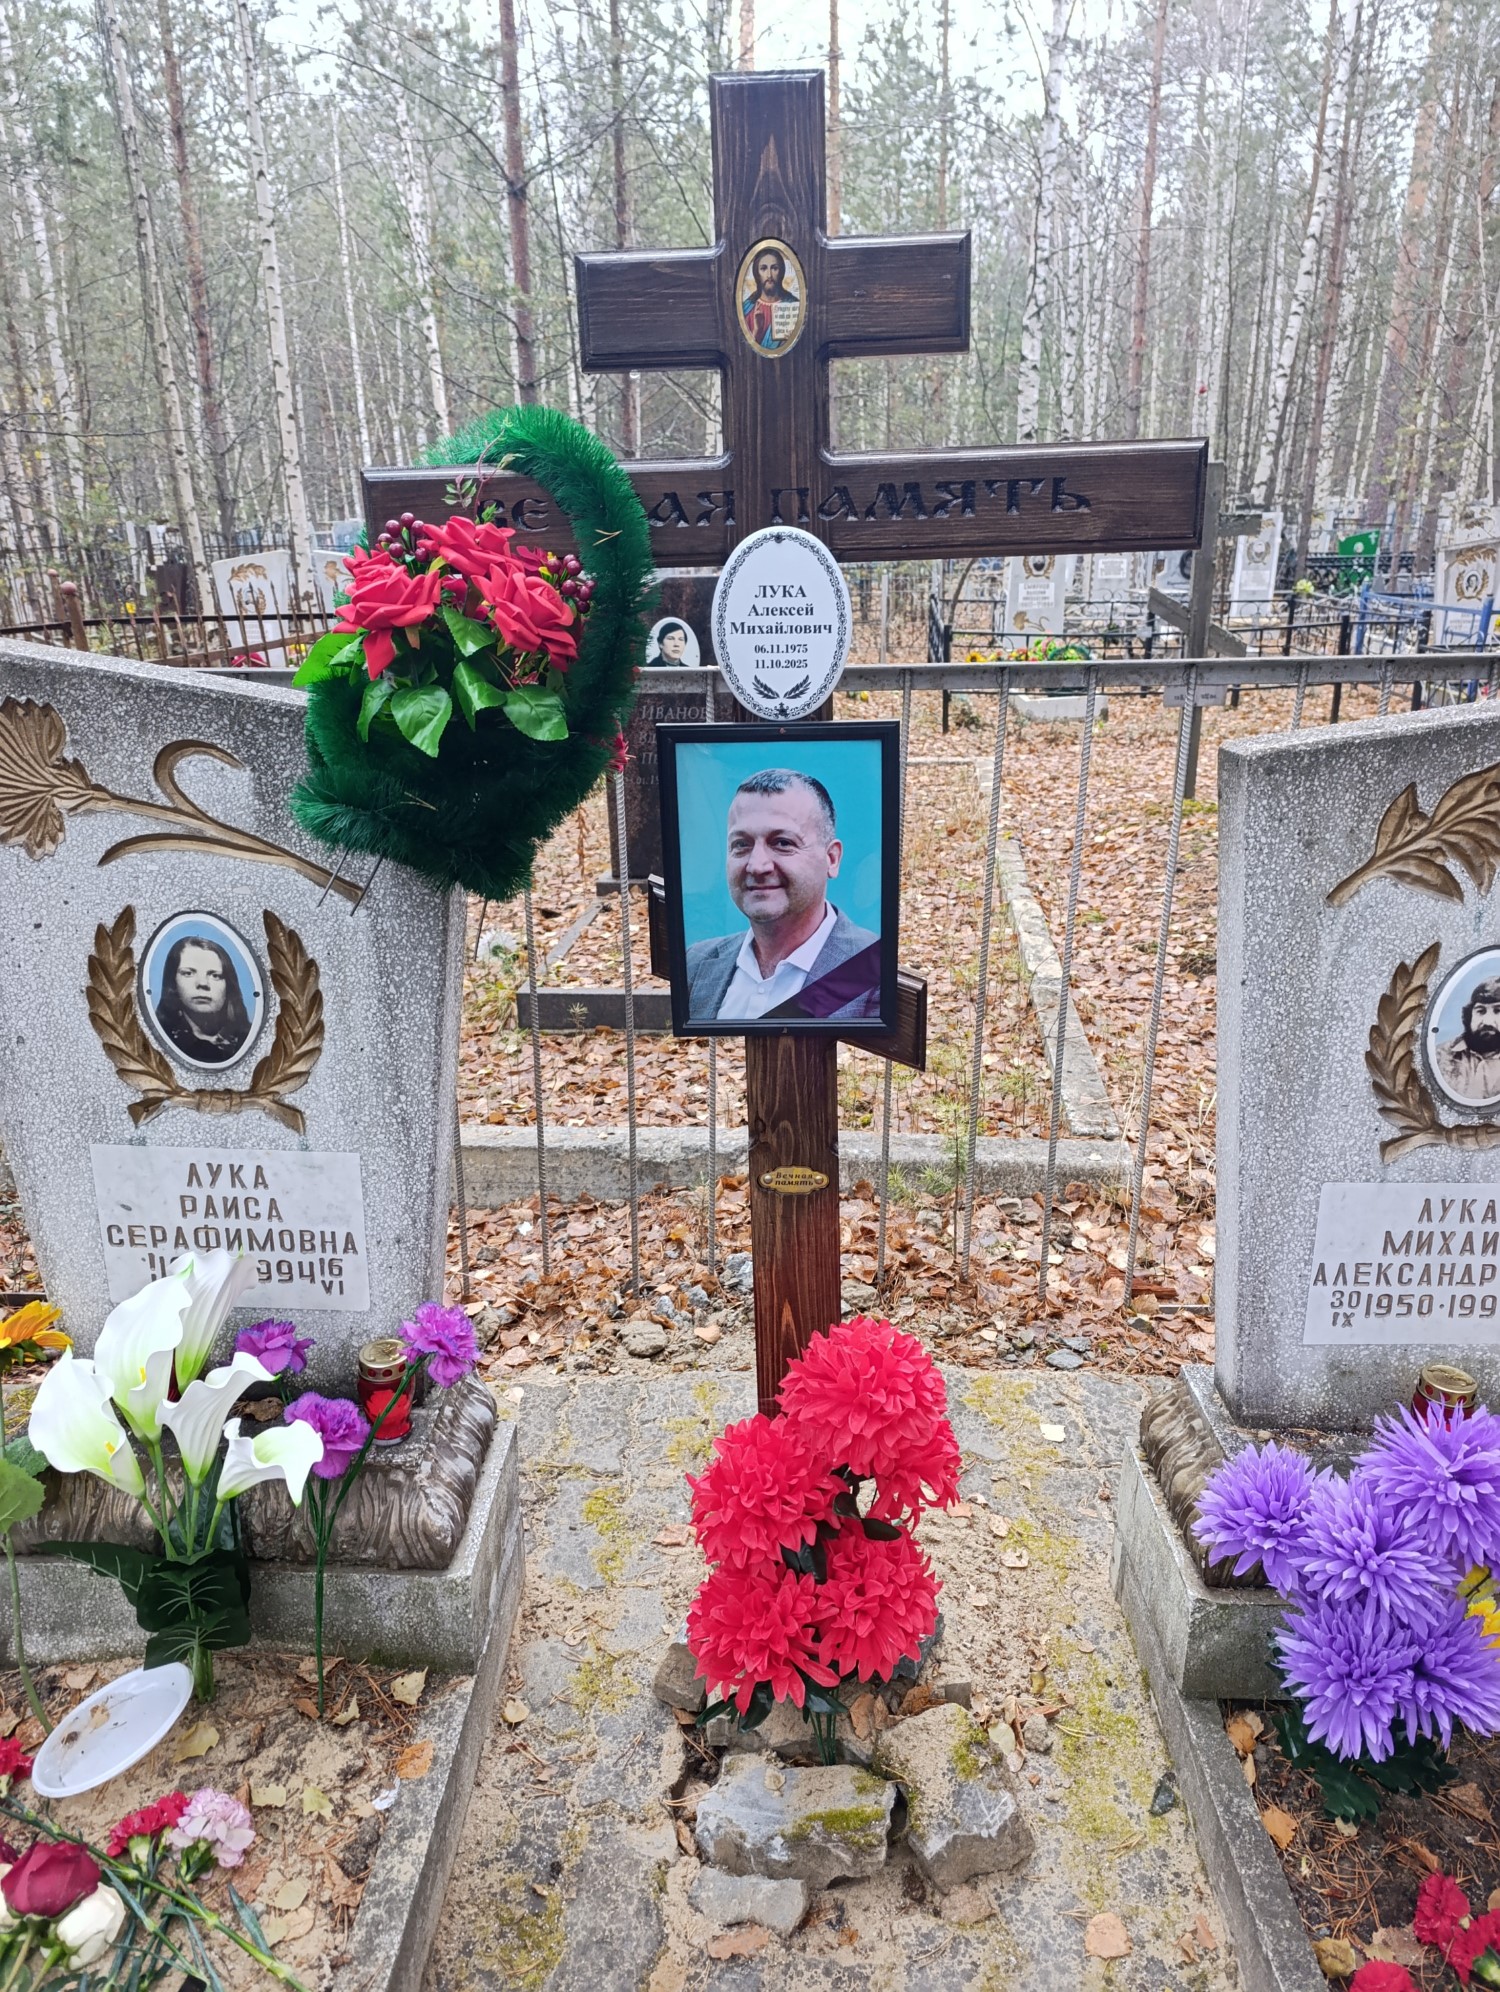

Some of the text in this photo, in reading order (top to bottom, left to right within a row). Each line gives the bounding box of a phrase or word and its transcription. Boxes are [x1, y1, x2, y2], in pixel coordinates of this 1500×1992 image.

[477, 477, 1092, 532] ВЕАЯ ПАМЯТЬ
[754, 585, 807, 598] ЛУКА
[748, 603, 814, 617] Алексей
[730, 621, 832, 635] Михайлович
[754, 644, 808, 654] 06.11.1975
[754, 659, 808, 669] 11.10.2025
[186, 1162, 270, 1190] ЛУКА
[775, 1172, 813, 1180] Вечная
[179, 1194, 284, 1222] РАИСА
[1417, 1197, 1498, 1225] ЛУКА
[106, 1223, 358, 1256] СЕРАФИМОВНА
[1312, 1262, 1498, 1288] АЛЕКСАНДР
